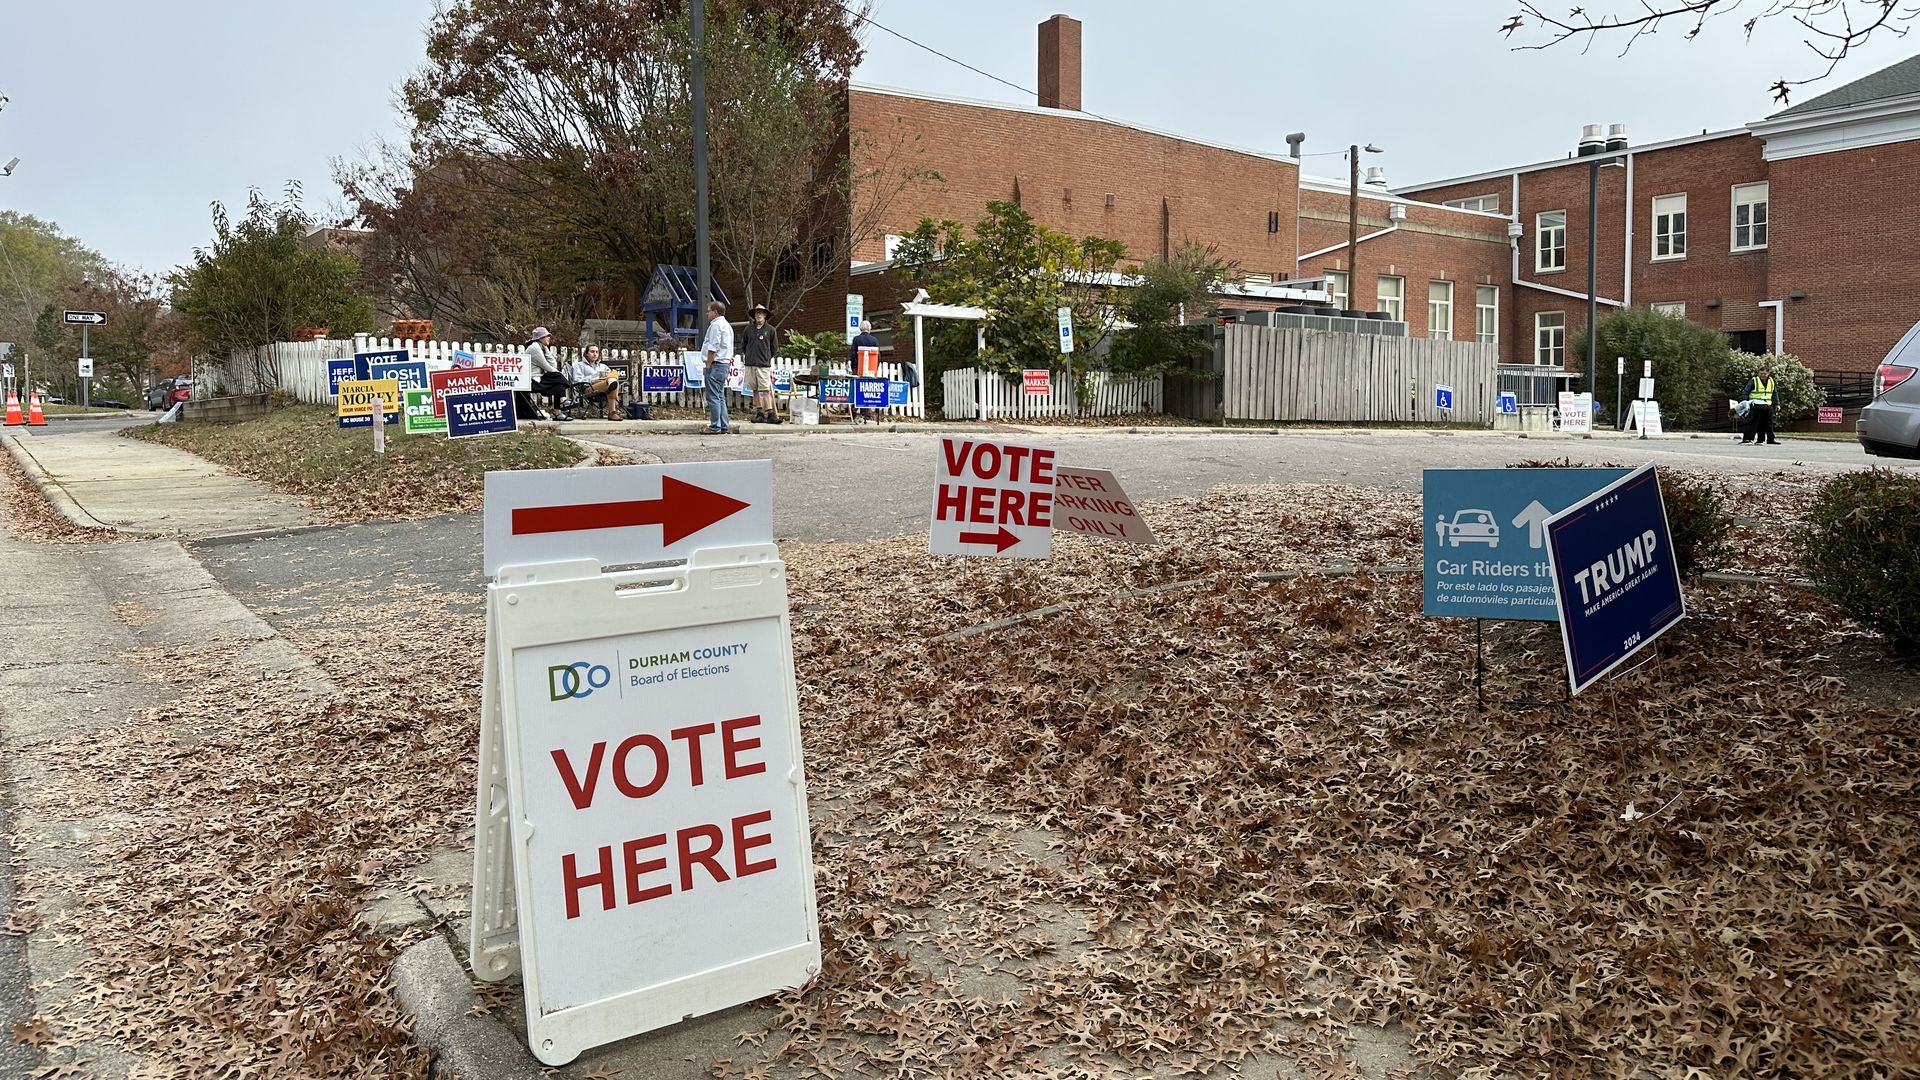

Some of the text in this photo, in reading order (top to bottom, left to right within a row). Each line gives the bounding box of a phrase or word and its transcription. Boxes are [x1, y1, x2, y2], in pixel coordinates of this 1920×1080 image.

[365, 355, 398, 364] VOTE
[483, 356, 522, 365] TRUMP
[380, 368, 420, 380] JOSH
[644, 367, 684, 378] TRUMP
[447, 376, 479, 387] MARK
[824, 379, 851, 388] JOSH
[859, 381, 885, 393] HARRIS
[342, 385, 375, 394] MARCIA
[824, 388, 850, 397] STEIN
[453, 399, 507, 414] TRUMP
[460, 410, 503, 423] VANCE
[942, 438, 1056, 486] VOTE
[936, 484, 1053, 528] HERE
[1054, 493, 1136, 517] ARKING
[1068, 516, 1127, 538] ONLY
[1436, 559, 1553, 578] Car Riders th
[1573, 529, 1657, 605] TRUMP
[1436, 580, 1454, 591] Por
[1454, 582, 1476, 592] este
[1477, 582, 1498, 592] lado
[1499, 582, 1515, 593] los
[1584, 564, 1659, 618] MAKE AMERICA GREAT AGAIN!
[1436, 593, 1449, 603] de
[1450, 594, 1509, 605] automóviles
[1623, 631, 1641, 651] 2024
[629, 642, 749, 670] DURHAM COUNTY
[630, 663, 730, 687] Board of Elections
[550, 714, 767, 811] VOTE
[561, 809, 778, 920] HERE
